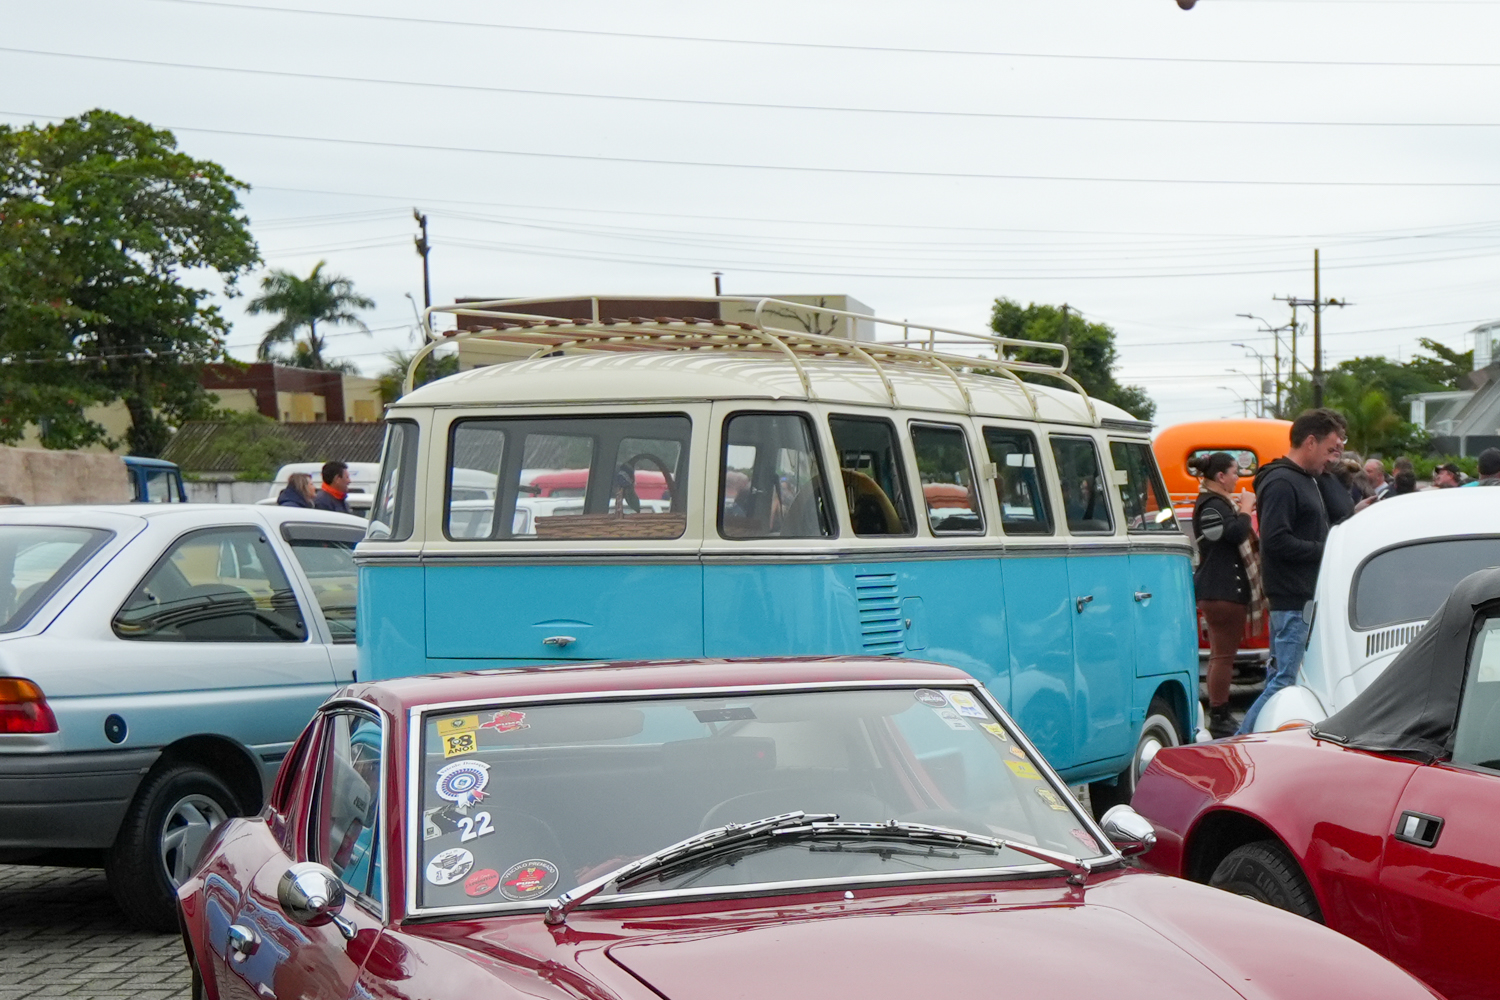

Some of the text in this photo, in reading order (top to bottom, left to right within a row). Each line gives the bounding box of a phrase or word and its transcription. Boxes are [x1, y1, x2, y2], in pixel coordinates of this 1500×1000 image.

[447, 734, 473, 749] 18
[447, 745, 474, 755] ANOS
[457, 811, 495, 842] 22
